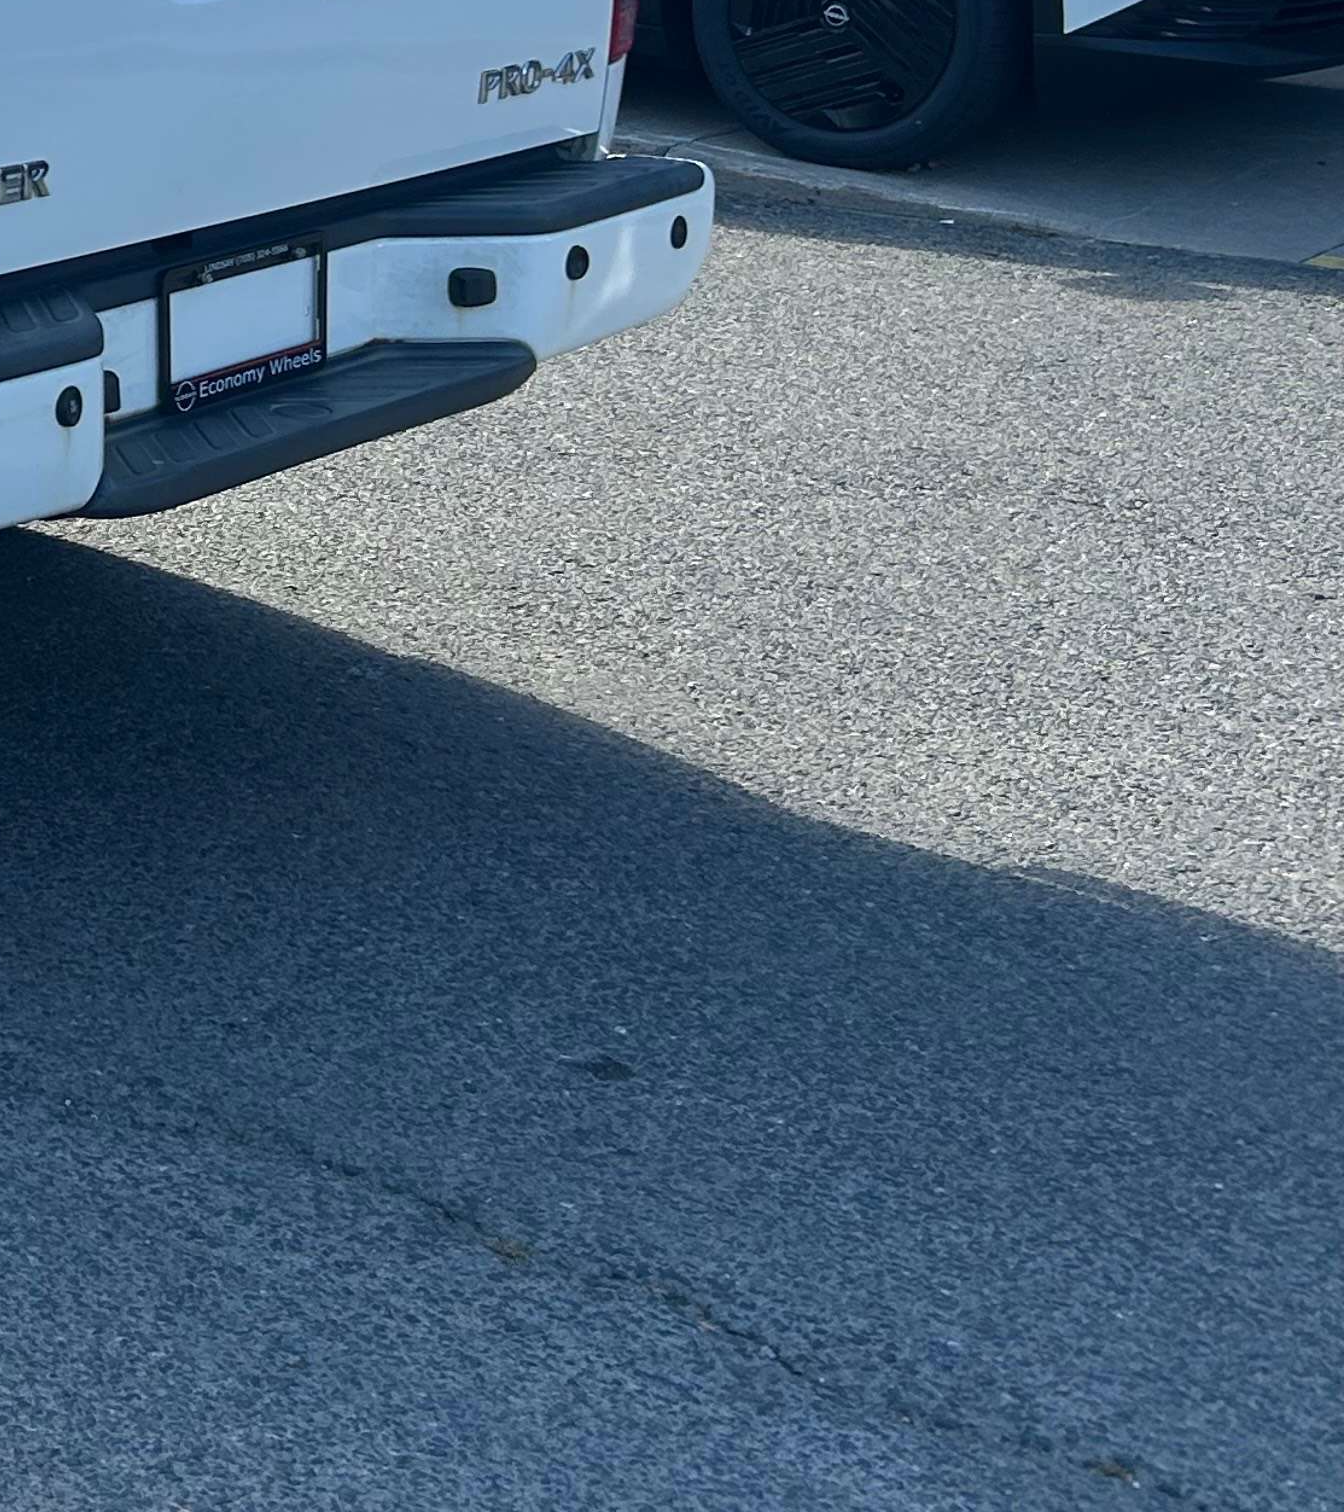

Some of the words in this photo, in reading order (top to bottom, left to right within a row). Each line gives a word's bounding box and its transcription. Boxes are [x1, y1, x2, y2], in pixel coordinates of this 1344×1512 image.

[477, 46, 596, 105] PRO-4X
[199, 366, 265, 399] Economy
[269, 347, 322, 376] Wheels
